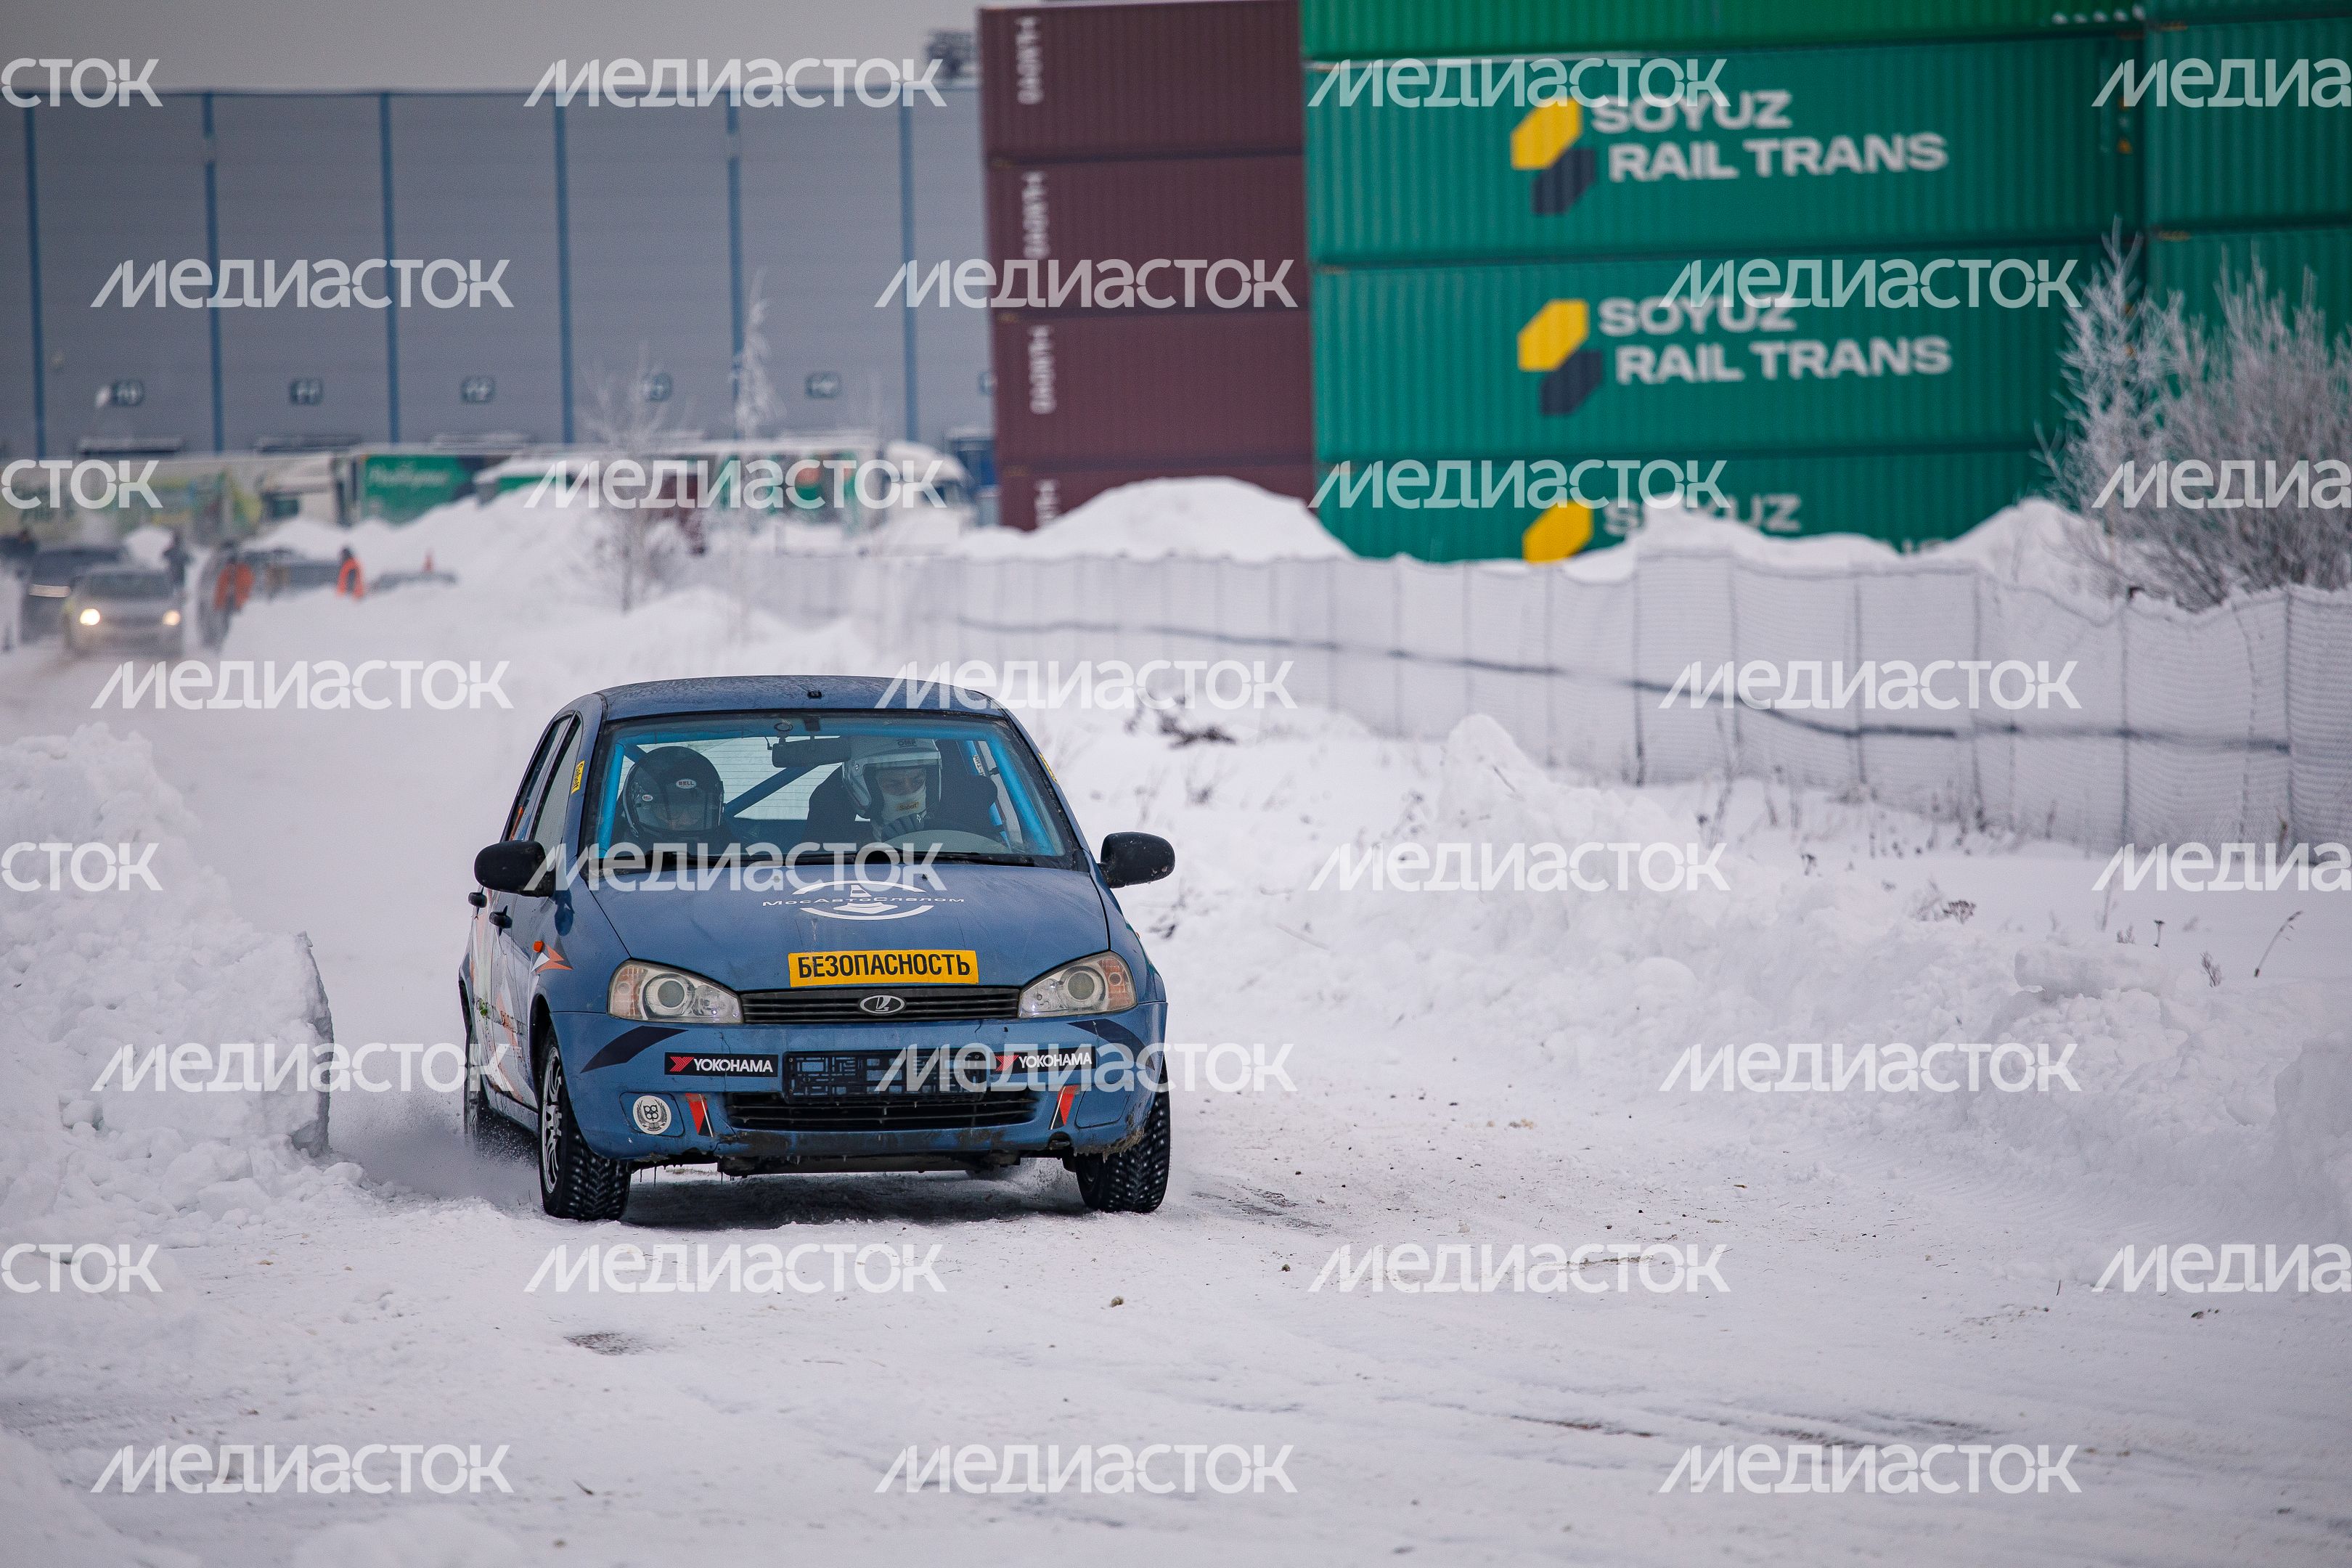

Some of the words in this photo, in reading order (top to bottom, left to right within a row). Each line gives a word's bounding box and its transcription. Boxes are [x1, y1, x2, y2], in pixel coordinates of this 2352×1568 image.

[1591, 89, 1792, 134] SOYUZ
[1609, 141, 1739, 182] RAIL
[1742, 132, 1948, 178] TRANS
[1598, 293, 1797, 337] SOYUZ
[1614, 343, 1744, 385] RAIL
[1750, 335, 1952, 381] TRANS
[798, 953, 971, 979] БЕЗОПАСНОСТЬ
[693, 1058, 773, 1073] YOKOHAMA
[1019, 1053, 1093, 1069] YOKOHAMA
